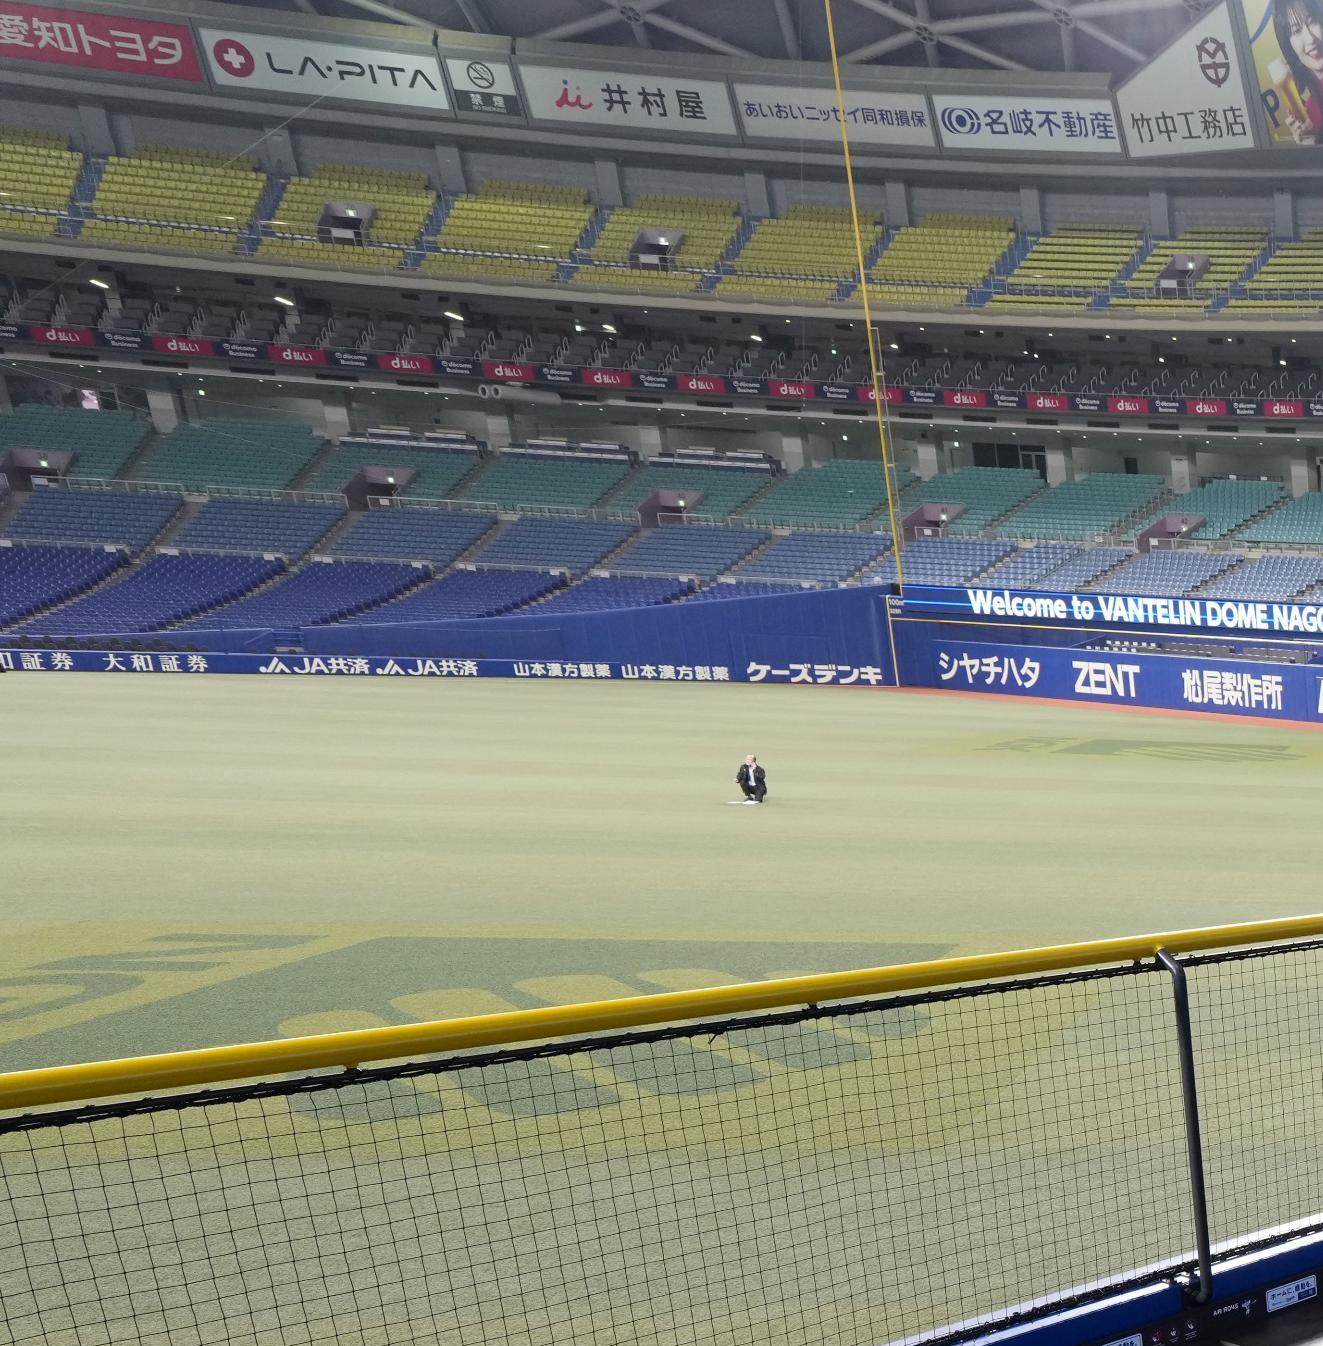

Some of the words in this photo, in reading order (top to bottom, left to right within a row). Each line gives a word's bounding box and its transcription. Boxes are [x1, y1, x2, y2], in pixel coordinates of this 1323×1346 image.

[0, 14, 182, 65] 愛知トヨタ
[601, 83, 708, 120] 井村屋
[743, 101, 929, 129] あいおいニッセイ同和損保
[983, 108, 1117, 141] 名岐不動産
[1131, 106, 1248, 143] 竹中工務店
[968, 589, 1067, 620] Welcome
[1072, 596, 1095, 621] to
[1099, 595, 1201, 627] VANTELIN
[1207, 601, 1270, 632] DOME
[104, 653, 209, 673] 大和証券
[293, 656, 370, 676] JA共済
[407, 658, 479, 677] JA共済
[513, 662, 611, 678] 山本漢方製薬
[621, 663, 730, 681] 山本漢方製薬
[746, 660, 883, 685] ケーズデンキ
[1072, 660, 1140, 698] ZENT
[1182, 668, 1284, 710] 松尾製作所
